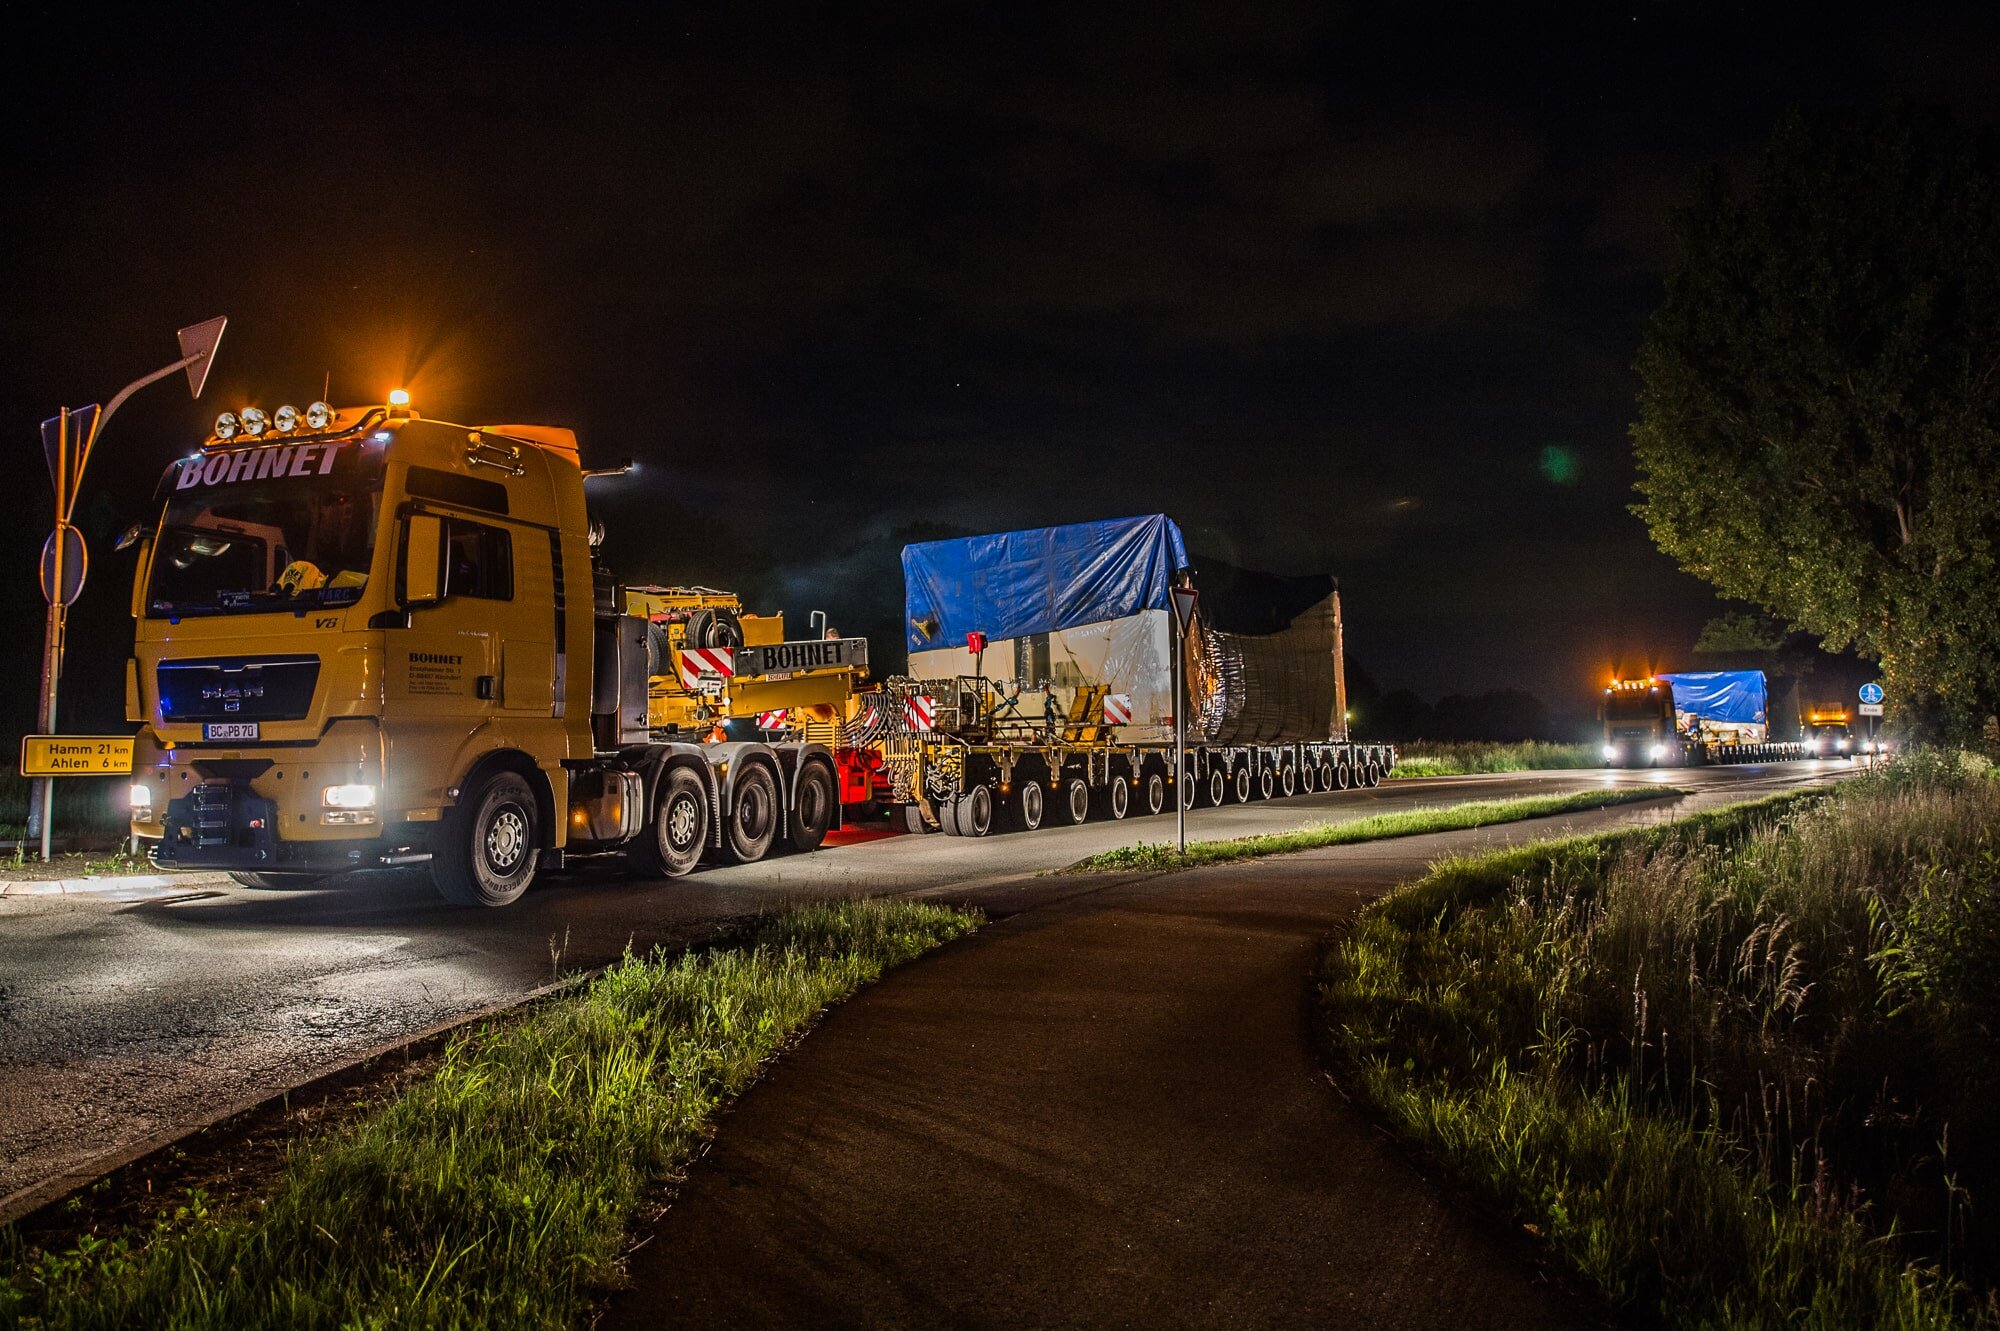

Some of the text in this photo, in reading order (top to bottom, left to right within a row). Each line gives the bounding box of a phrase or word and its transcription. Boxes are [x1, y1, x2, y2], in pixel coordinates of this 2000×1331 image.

[176, 443, 347, 490] BOHNET
[315, 617, 338, 629] V8
[409, 653, 463, 664] BOHNET
[763, 643, 843, 670] BOHNET
[210, 725, 254, 737] BC PB 70
[49, 744, 92, 755] Hamm
[98, 744, 110, 754] 21
[51, 758, 89, 768] Ahlen
[102, 758, 109, 768] 6
